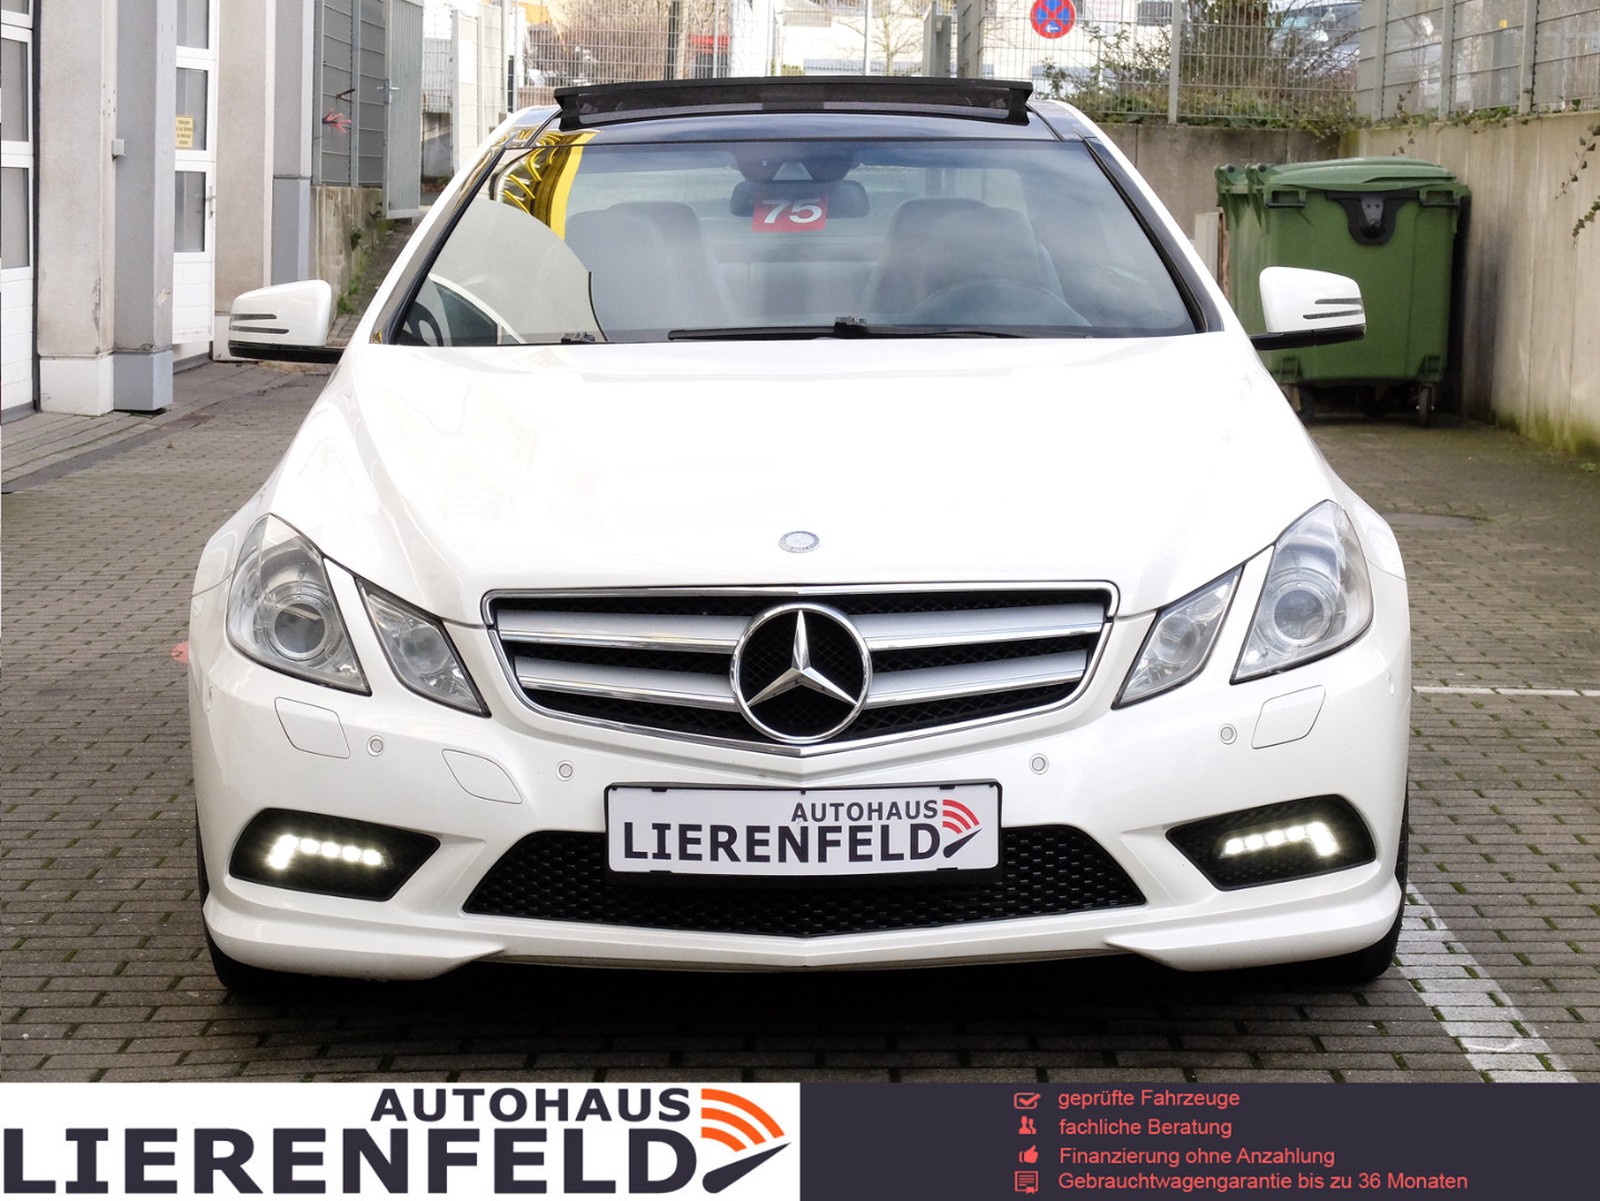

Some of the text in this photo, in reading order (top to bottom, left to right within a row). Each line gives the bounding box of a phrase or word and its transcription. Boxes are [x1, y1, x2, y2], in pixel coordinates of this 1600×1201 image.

[762, 199, 822, 223] 75
[791, 800, 938, 822] AUTOHAUS
[624, 822, 941, 863] LIERENFELD
